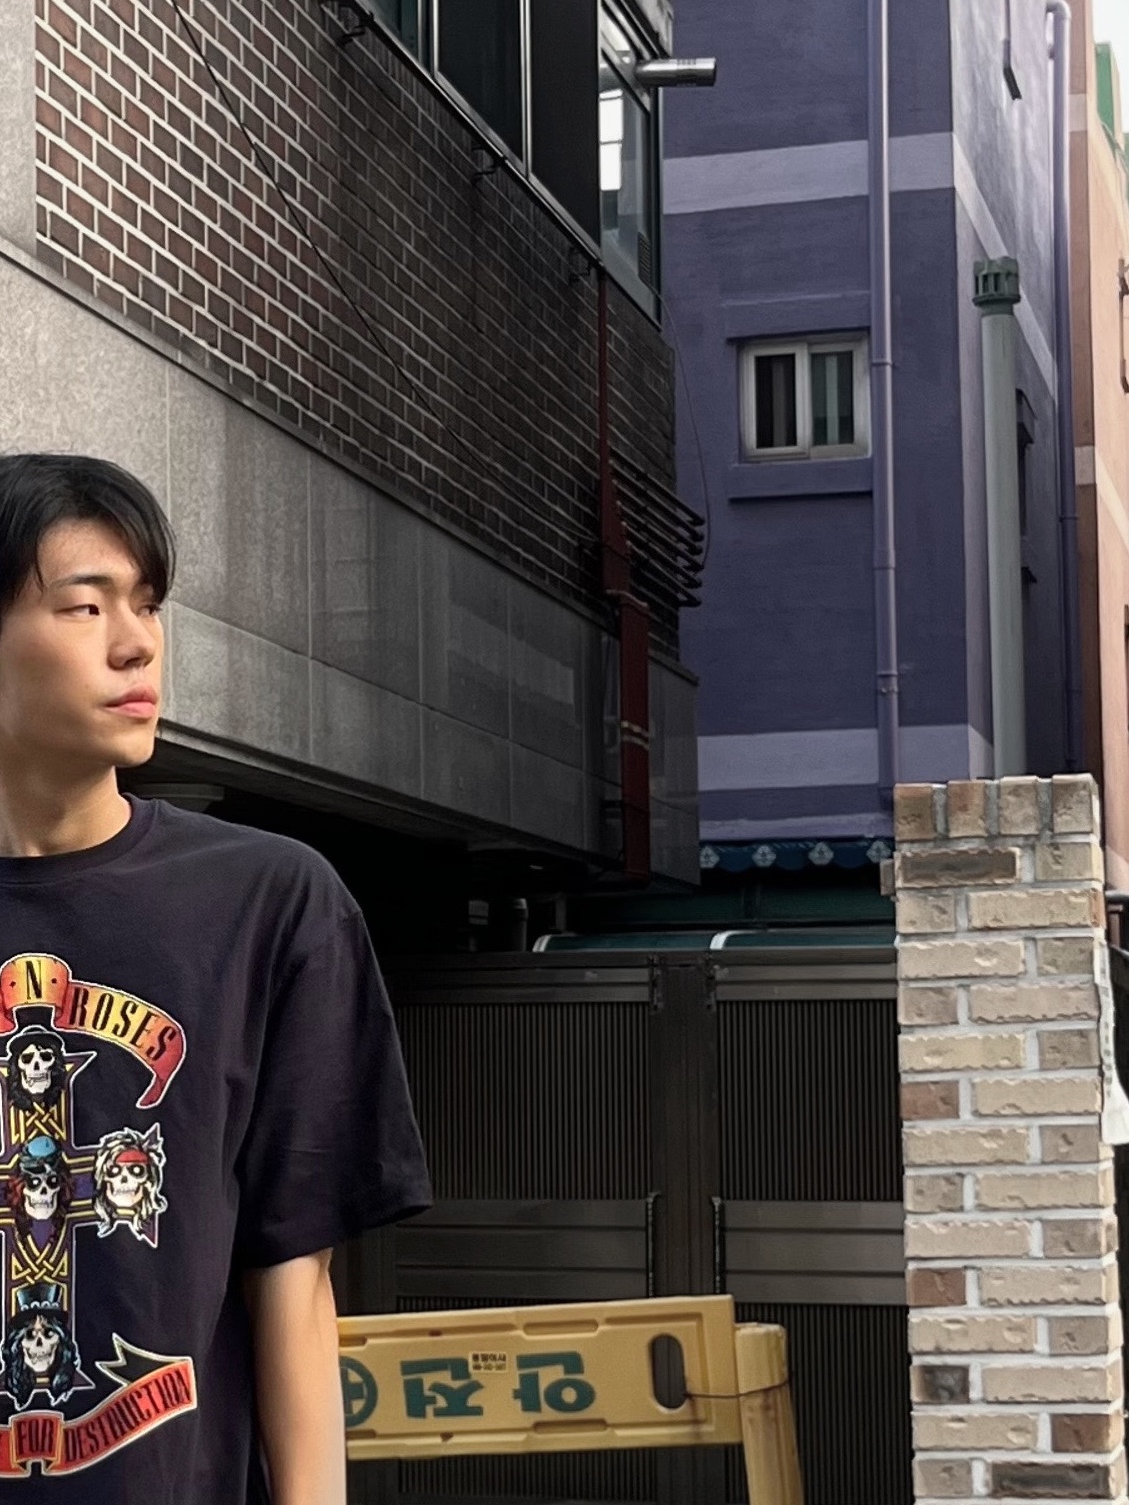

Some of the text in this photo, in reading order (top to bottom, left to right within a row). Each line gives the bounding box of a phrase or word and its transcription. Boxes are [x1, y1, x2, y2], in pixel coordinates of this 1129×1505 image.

[25, 959, 43, 1000] N
[67, 986, 177, 1062] ROSES
[17, 1418, 54, 1455] FOR
[64, 1369, 191, 1463] DESTRUCTION
